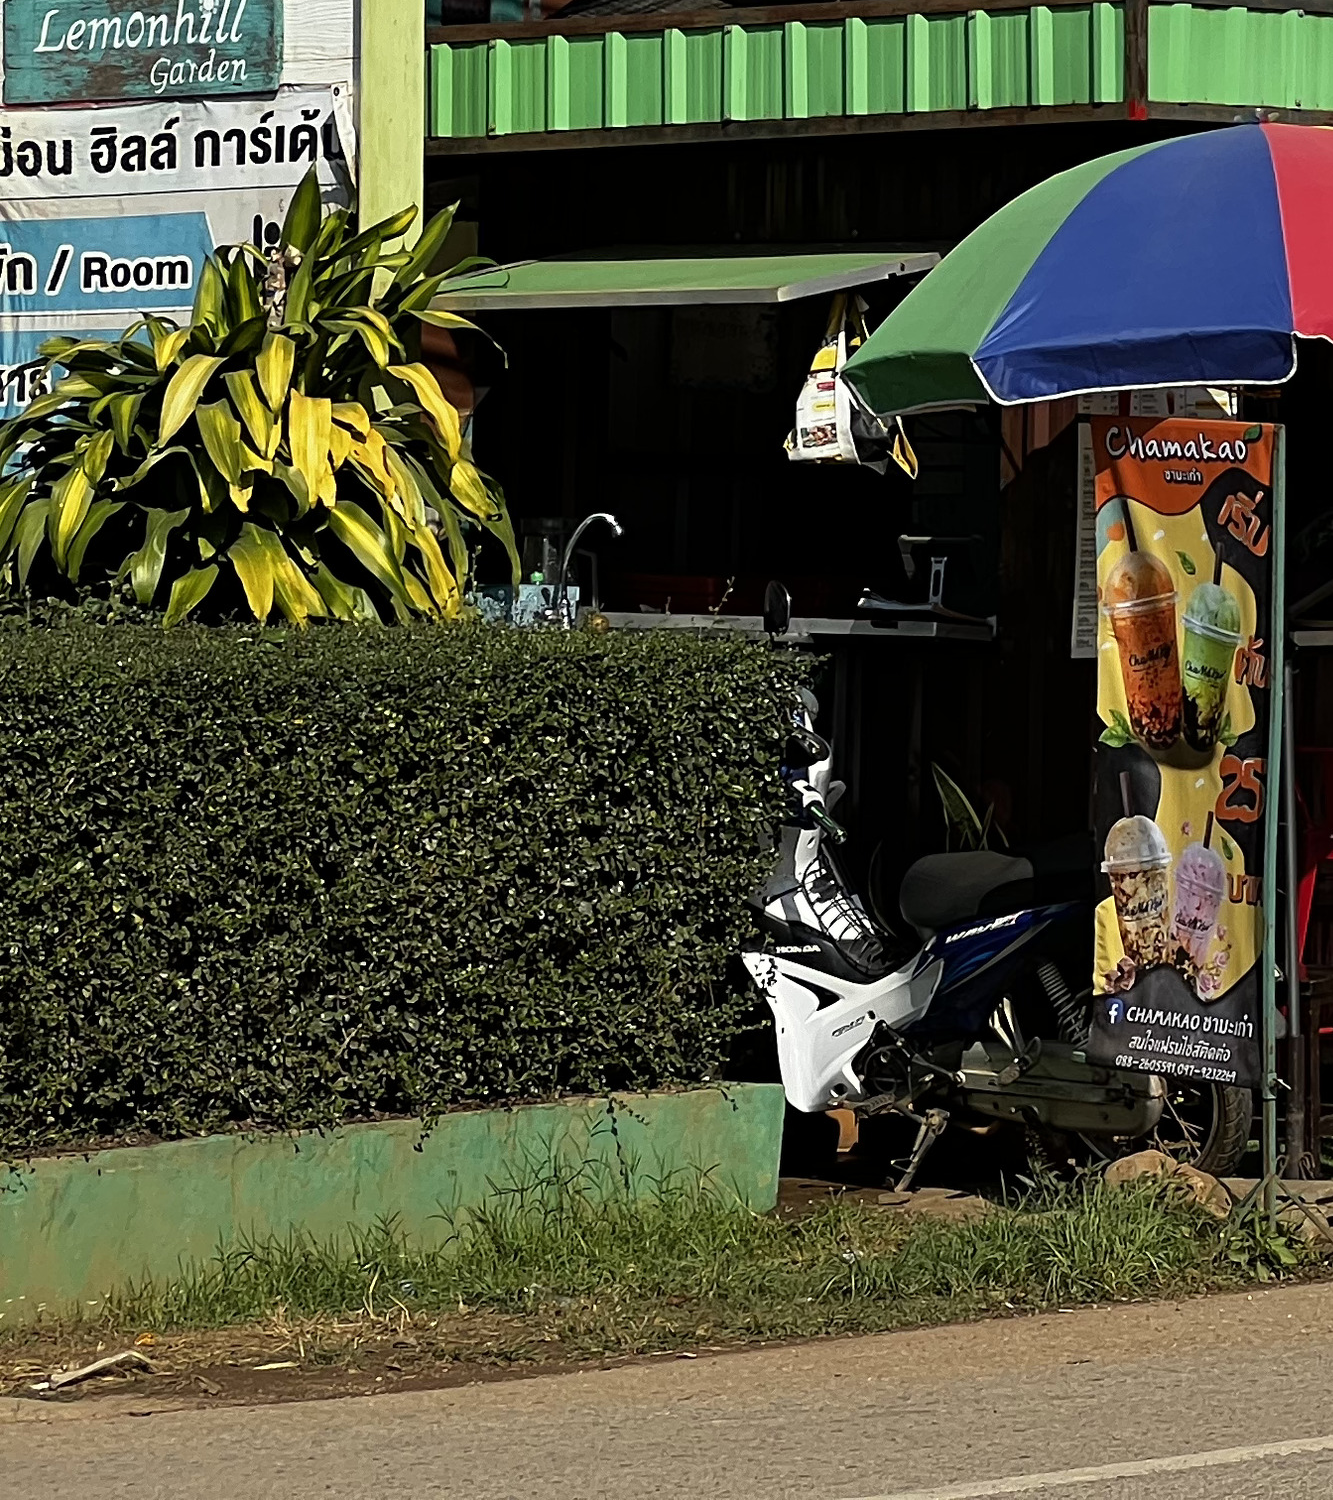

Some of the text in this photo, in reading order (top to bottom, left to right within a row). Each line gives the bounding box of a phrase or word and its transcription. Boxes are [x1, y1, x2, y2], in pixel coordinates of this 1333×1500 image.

[150, 49, 247, 94] Garden
[90, 117, 180, 173] ฮิลล์
[83, 256, 189, 288] Room
[1106, 426, 1247, 460] Chamakao
[1215, 755, 1266, 823] 25
[776, 945, 821, 954] HONDA
[1127, 1006, 1200, 1031] CHAMAKAO
